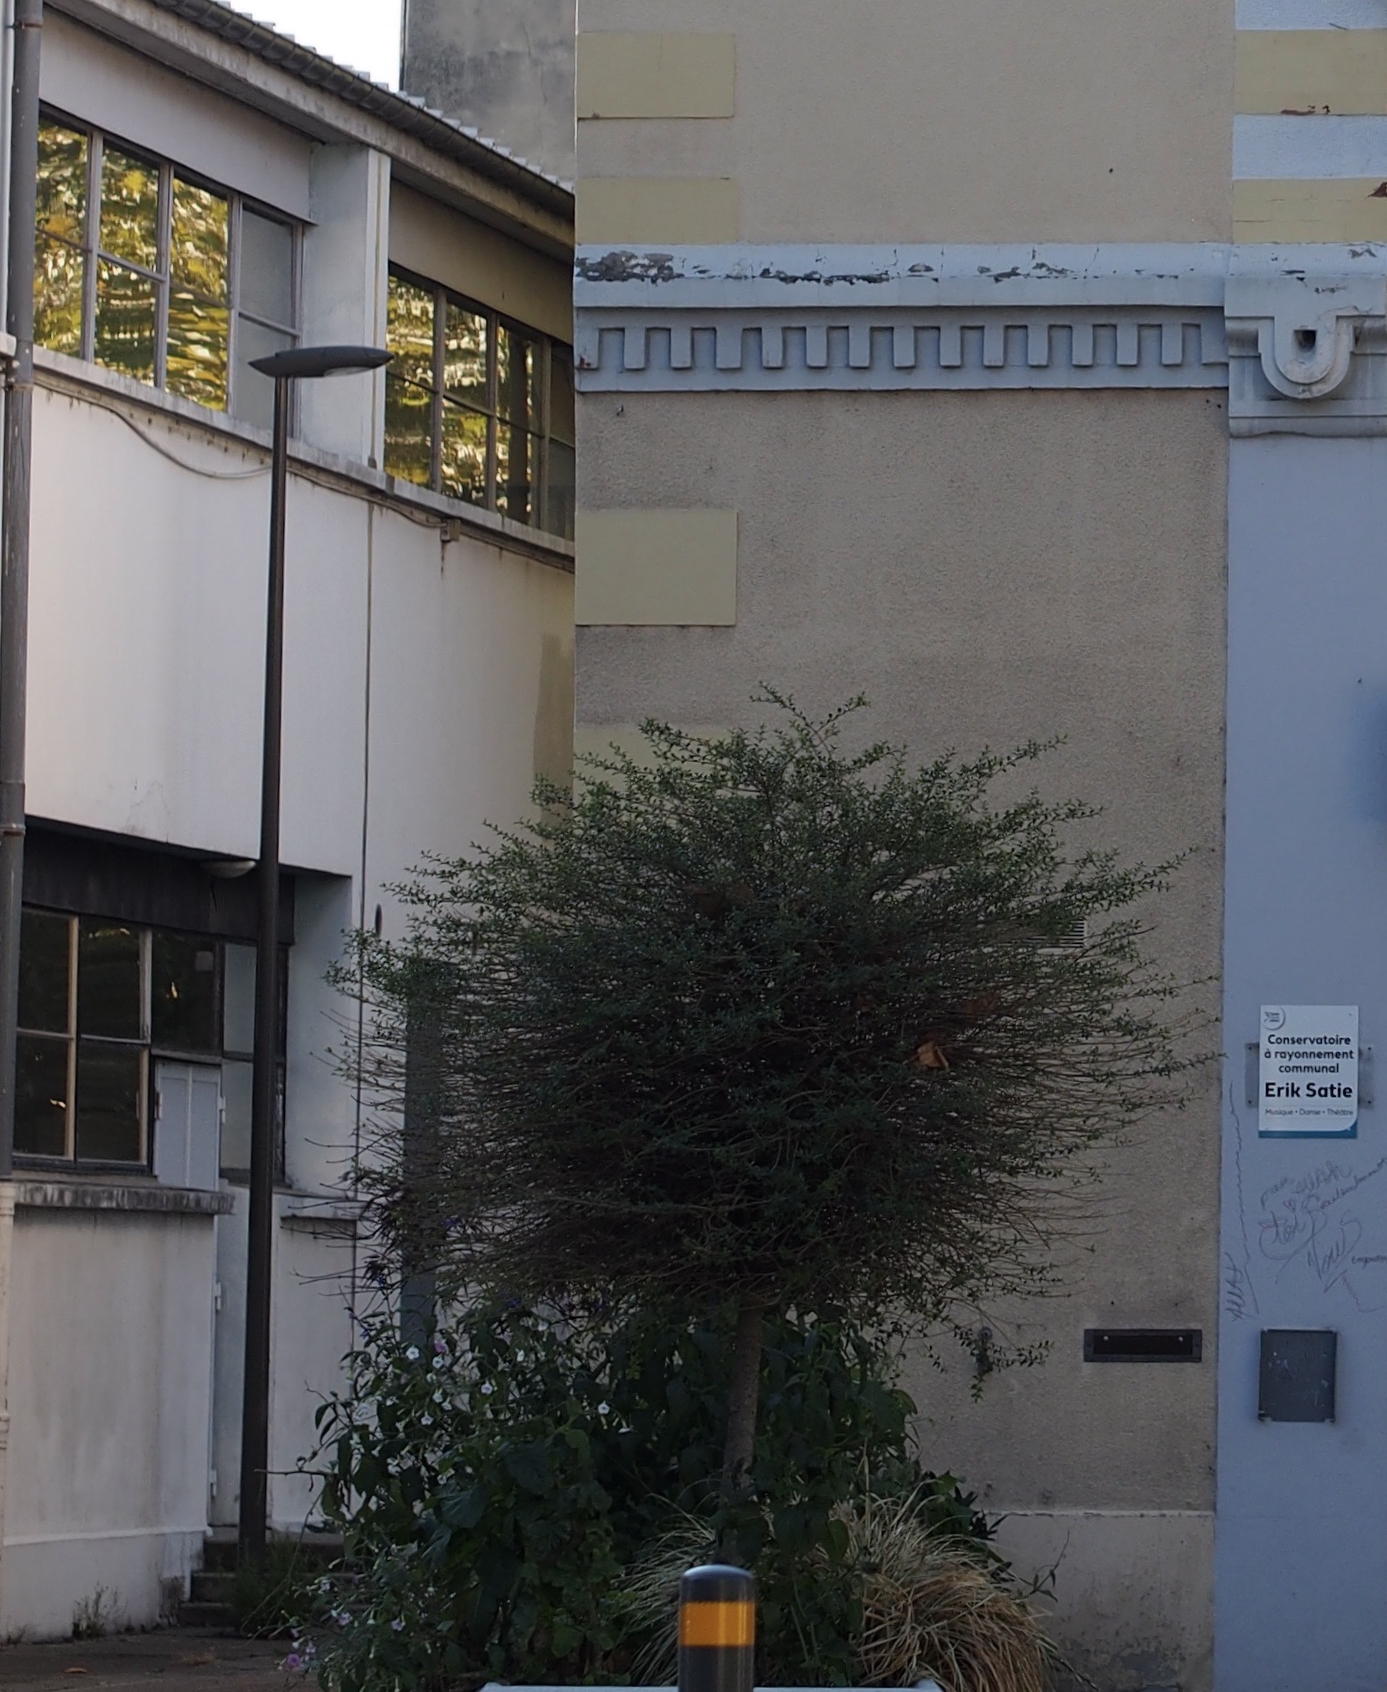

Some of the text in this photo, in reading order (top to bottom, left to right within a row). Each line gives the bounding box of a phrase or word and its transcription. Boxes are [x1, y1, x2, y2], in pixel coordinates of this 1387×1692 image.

[1267, 1034, 1352, 1046] Conservatoire
[1263, 1048, 1355, 1062] à rayonnement
[1278, 1063, 1340, 1074] communal
[1264, 1082, 1353, 1099] Erik Satie
